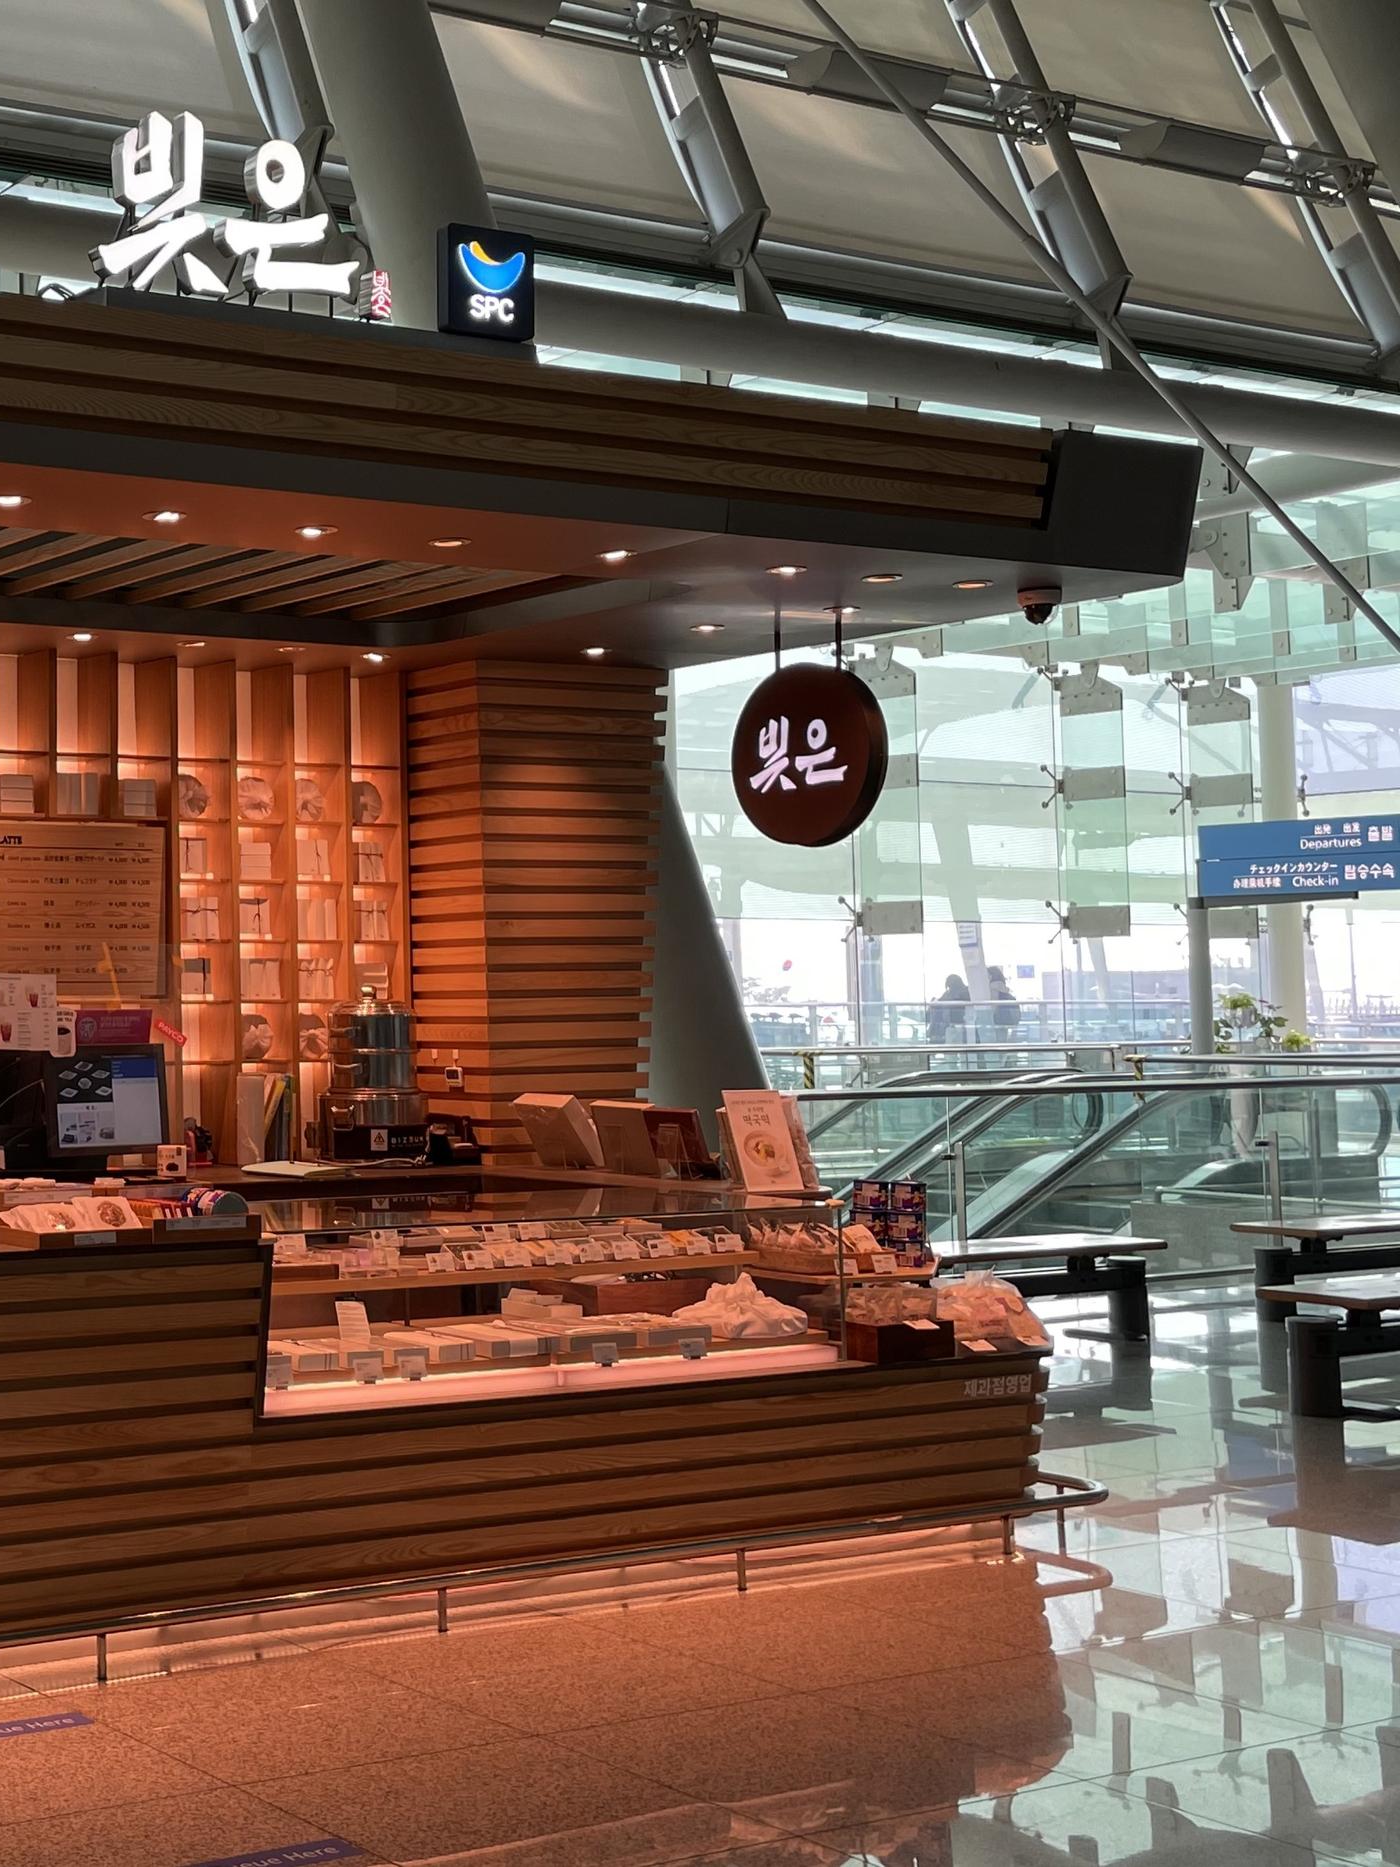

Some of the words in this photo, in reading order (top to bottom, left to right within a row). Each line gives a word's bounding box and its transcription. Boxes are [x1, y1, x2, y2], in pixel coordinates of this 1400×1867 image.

[93, 110, 362, 295] 빚은
[468, 293, 515, 323] SPC
[749, 715, 849, 794] 빚은
[1367, 825, 1394, 842] 출발
[1299, 836, 1362, 851] Departures
[1249, 860, 1338, 874] チェックインカウンター
[1344, 863, 1396, 880] 탑승수속
[1292, 875, 1340, 888] Check-in
[157, 1020, 186, 1044] PAYCO
[963, 1373, 1033, 1399] 제과점영업
[26, 1716, 76, 1732] Here
[282, 1847, 342, 1863] Here
